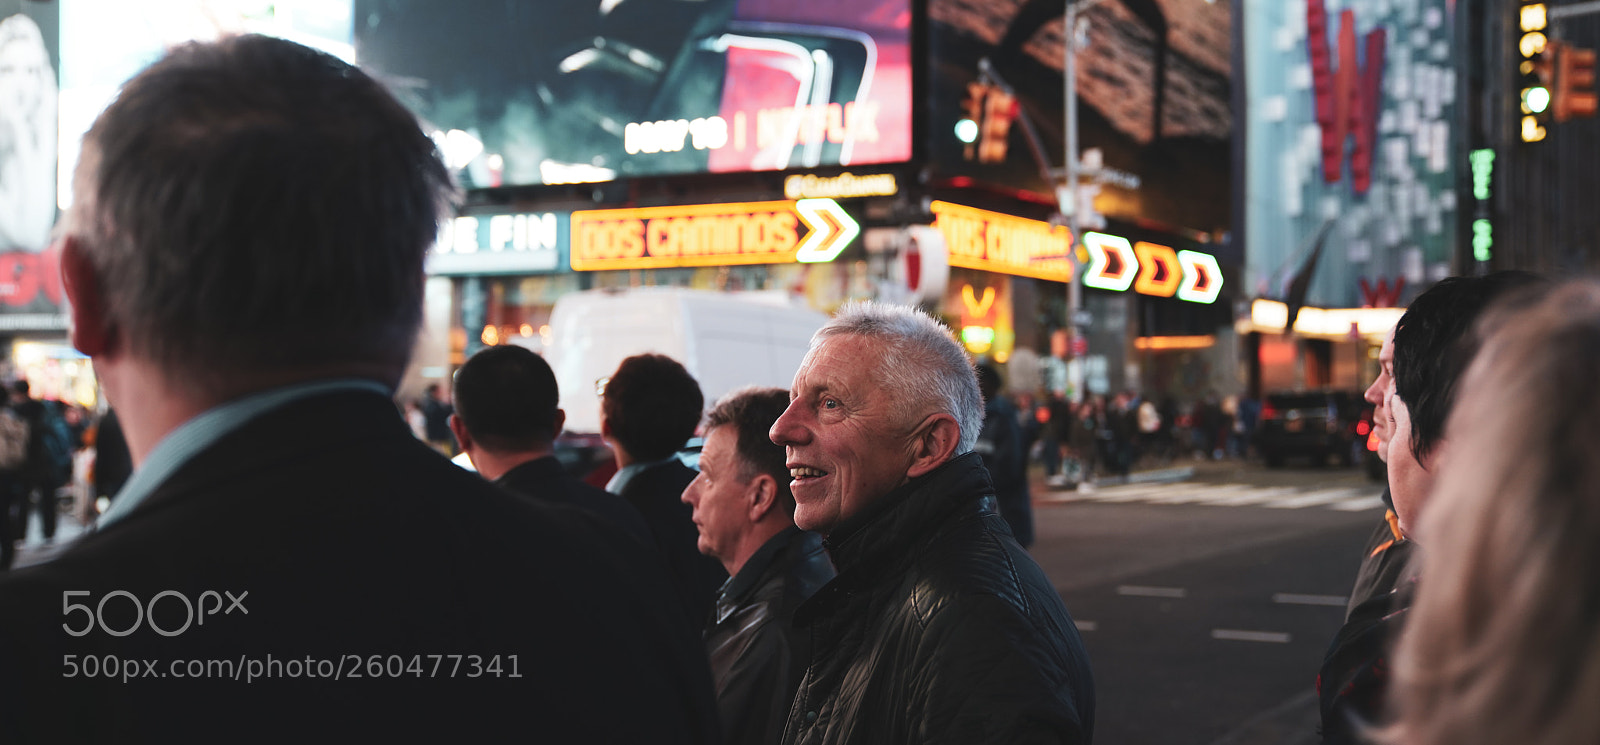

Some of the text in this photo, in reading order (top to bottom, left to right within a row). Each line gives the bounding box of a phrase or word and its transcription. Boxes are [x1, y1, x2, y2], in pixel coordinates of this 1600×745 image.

[490, 213, 557, 251] FIN
[582, 211, 799, 259] DOS CAMINOS
